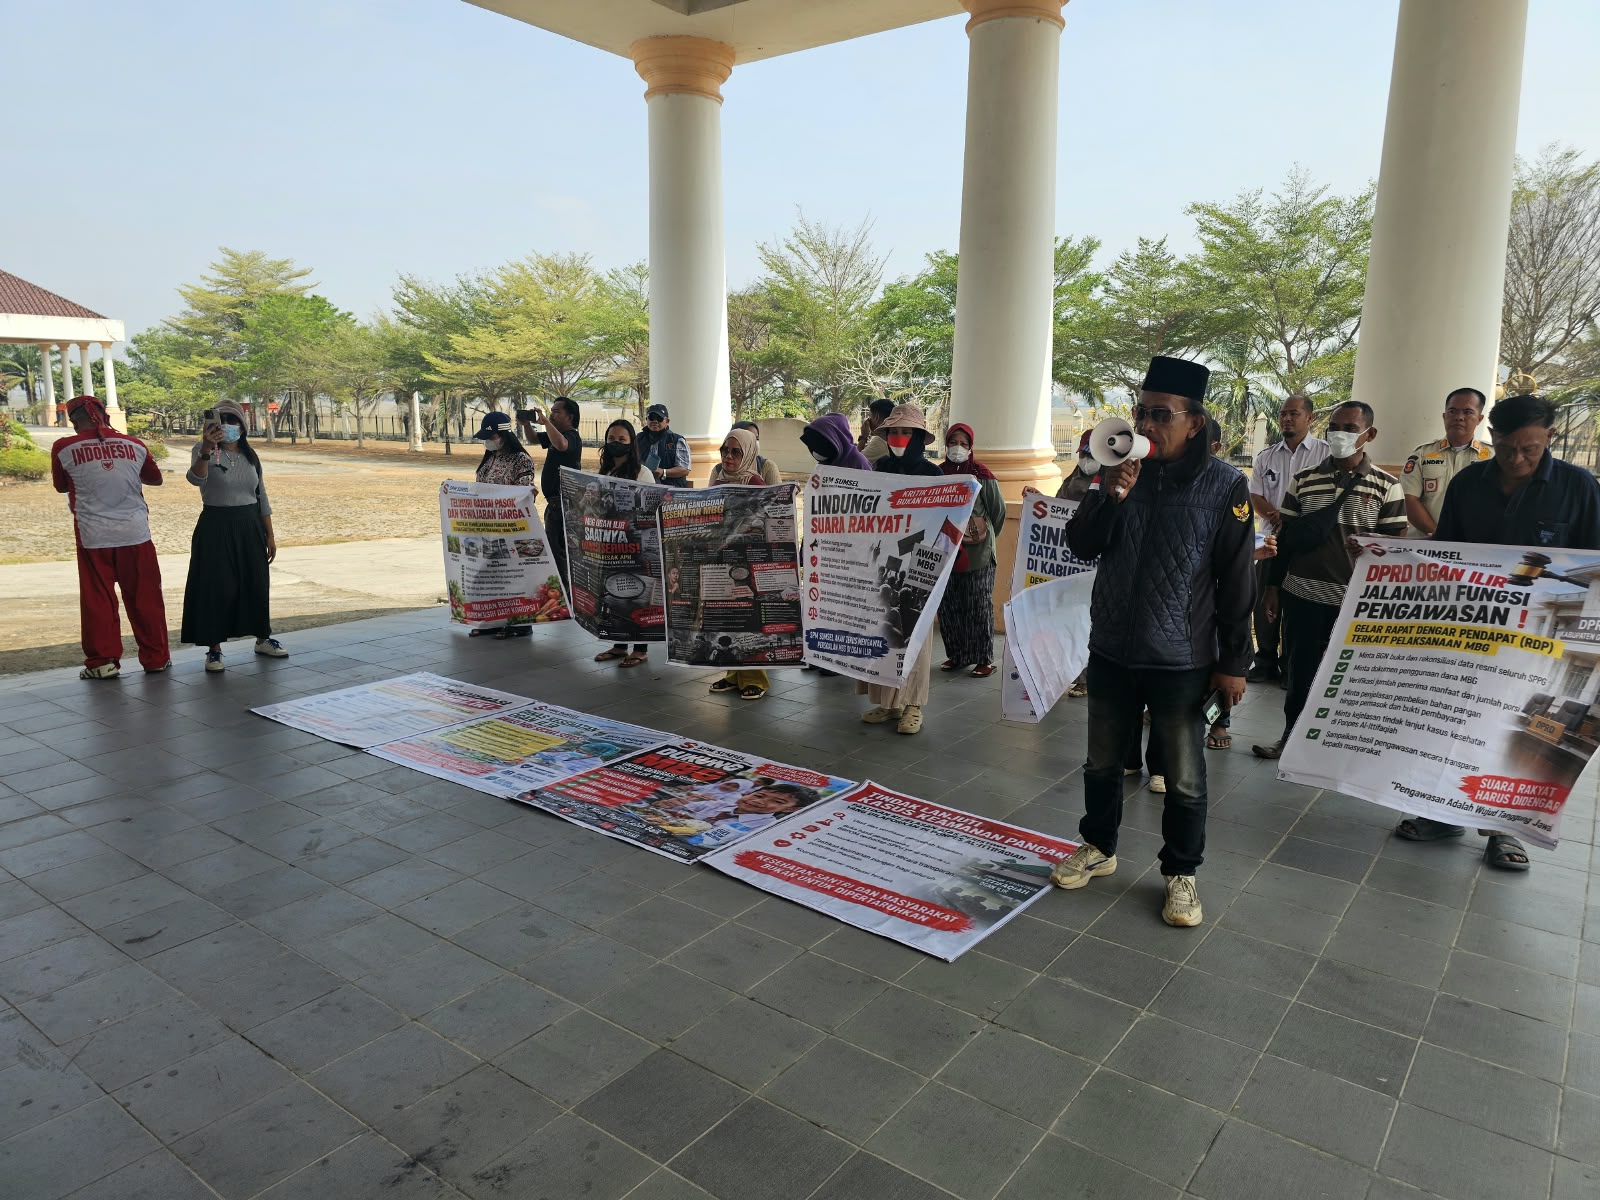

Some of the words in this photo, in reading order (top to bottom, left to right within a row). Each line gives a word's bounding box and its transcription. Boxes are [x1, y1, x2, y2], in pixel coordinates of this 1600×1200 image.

[72, 445, 137, 466] INDONESIA
[835, 478, 858, 487] SUMSEL
[495, 498, 516, 508] PASOK
[662, 503, 686, 512] DUGAAN
[811, 494, 881, 515] LINDUNGI
[923, 494, 967, 504] KEJAHATAN!
[499, 509, 525, 519] HARGA
[662, 508, 701, 520] KESEHATAN
[1050, 505, 1069, 516] SPM
[811, 516, 844, 534] SUARA
[848, 515, 904, 533] RAKYAT
[905, 514, 912, 533] !
[585, 527, 628, 543] SAATNYA
[916, 549, 942, 563] AWASI
[1029, 543, 1057, 561] DATA
[917, 559, 935, 571] MBG
[1027, 557, 1038, 571] DI
[1365, 564, 1412, 582] DPRD
[1416, 563, 1466, 582] OGAN
[1468, 570, 1509, 588] ILIR
[1359, 585, 1450, 602] JALANKAN
[1456, 585, 1531, 607] FUNGSI
[1353, 602, 1510, 626] PENGAWASAN
[1517, 609, 1528, 629] !
[820, 632, 834, 640] SUMSEL
[1351, 634, 1389, 644] TERKAIT
[1390, 636, 1462, 649] PELAKSANAAN
[1464, 642, 1490, 652] MBG
[1354, 624, 1383, 633] GELAR
[1386, 625, 1415, 635] RAPAT
[1416, 626, 1456, 637] DENGAR
[1459, 629, 1517, 644] PENDAPAT
[1520, 635, 1554, 654] (RDP)
[1441, 672, 1458, 681] dana
[1460, 675, 1478, 685] MBG
[1458, 660, 1474, 668] data
[1476, 664, 1498, 673] resmi
[1498, 668, 1527, 680] seluruh
[1528, 675, 1547, 686] SPPG
[1397, 681, 1428, 691] penerima
[1429, 685, 1460, 696] manfaat
[1461, 691, 1475, 700] dan
[1476, 694, 1502, 708] jumlah
[1340, 698, 1359, 706] hingga
[1359, 700, 1387, 708] pemasok
[1402, 705, 1420, 714] bukti
[1421, 710, 1466, 725] pembayaran
[1430, 699, 1455, 711] bahan
[1453, 705, 1482, 718] pangan
[1382, 716, 1403, 725] tindak
[1405, 720, 1425, 730] lanjut
[1427, 724, 1448, 736] kasus
[1450, 730, 1486, 747] kesehatan
[1322, 740, 1343, 748] kepada
[1343, 743, 1381, 756] masyarakat
[1326, 731, 1358, 741] Sampaikan
[1358, 735, 1374, 744] hasil
[1374, 740, 1417, 755] pengawasan
[1419, 750, 1442, 762] secara
[1444, 757, 1480, 772] transparan
[632, 754, 728, 780] MBG
[656, 747, 745, 772] DUKUNG
[1480, 778, 1515, 792] SUARA
[1517, 784, 1558, 798] RAKYAT
[868, 792, 921, 810] TINDAK
[920, 806, 983, 827] LANJUTI
[1474, 790, 1510, 805] HARUS
[1512, 795, 1561, 811] DIDENGAR
[1447, 798, 1474, 812] Adalah
[1475, 805, 1498, 817] Wujud
[1498, 810, 1532, 824] Tanggung
[857, 796, 916, 816] KASUS
[916, 813, 1005, 841] KEAMANAN
[1002, 837, 1073, 861] PANGAN!
[756, 854, 816, 877] KESEHATAN
[816, 873, 854, 890] SANTRI
[854, 886, 881, 898] DAN
[882, 893, 959, 923] MASYARAKAT
[761, 863, 799, 879] BUKAN
[799, 875, 833, 890] UNTUK
[834, 886, 930, 922] DIPERTARUHKAN
